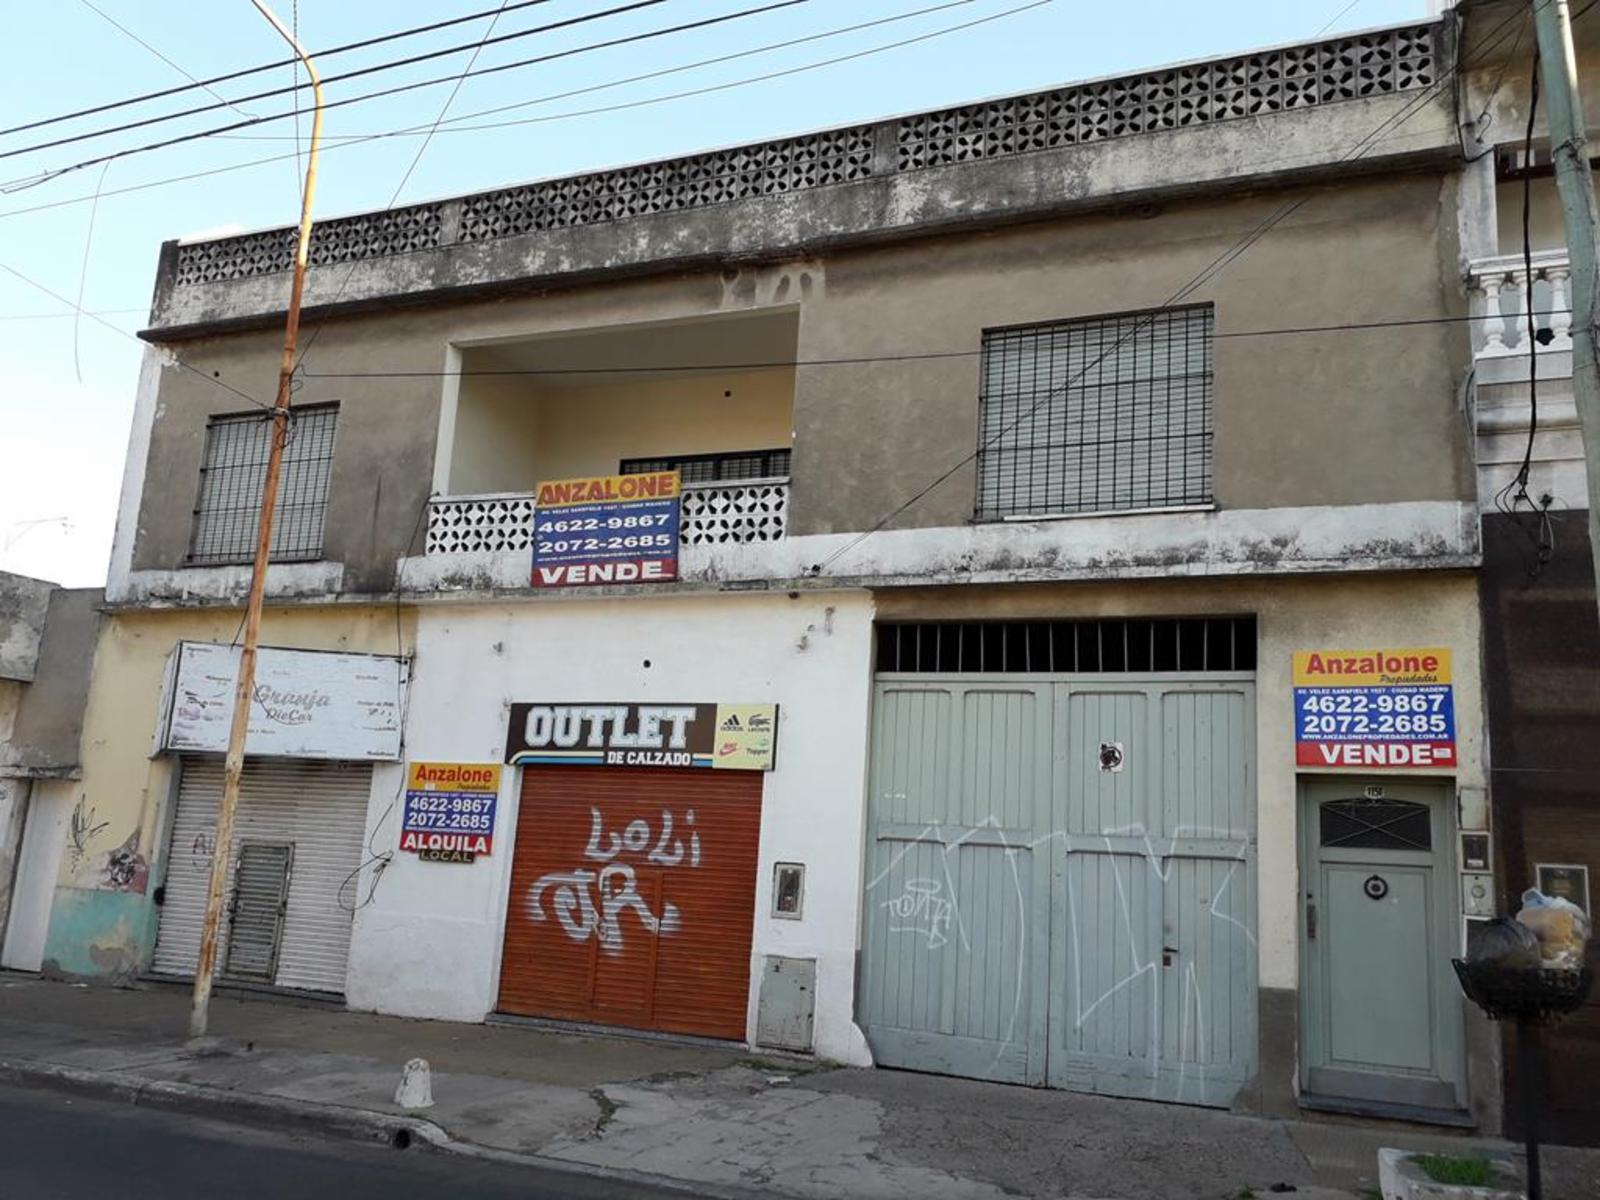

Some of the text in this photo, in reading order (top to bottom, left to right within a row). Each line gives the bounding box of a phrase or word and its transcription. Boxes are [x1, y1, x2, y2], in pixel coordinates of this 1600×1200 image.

[537, 474, 674, 505] ANZALONE
[538, 514, 670, 533] 4622-9867
[538, 534, 671, 553] 2072-2685
[539, 561, 662, 584] VENDE
[1306, 652, 1438, 675] Anzalone
[1379, 673, 1438, 685] Propiedades
[253, 684, 331, 710] Granja
[1303, 694, 1444, 713] 4622-9867
[524, 706, 696, 749] OUTLET
[1304, 715, 1446, 733] 2072-2685
[607, 752, 691, 766] DE CALZADO
[1319, 744, 1432, 764] VENDE
[415, 764, 493, 782] Anzalone
[409, 797, 492, 813] 4622-9867
[407, 812, 491, 829] 2072-2685
[403, 832, 488, 852] ALQUILA
[421, 850, 472, 861] LOCAL
